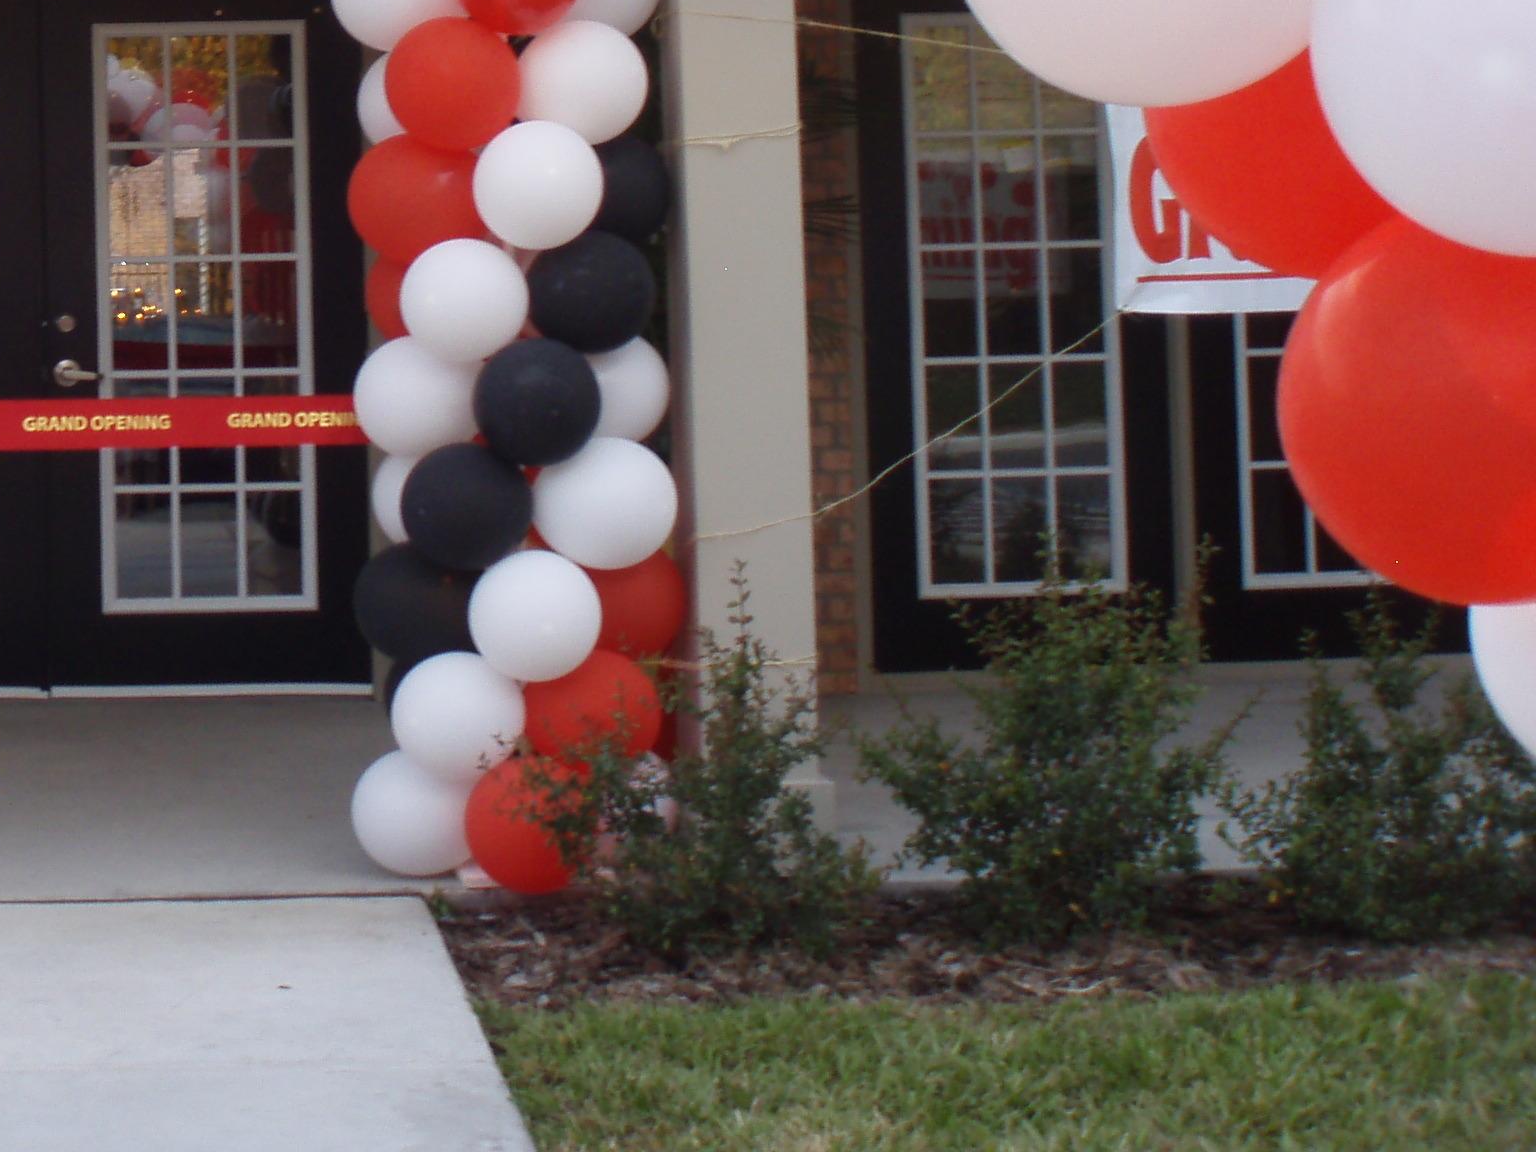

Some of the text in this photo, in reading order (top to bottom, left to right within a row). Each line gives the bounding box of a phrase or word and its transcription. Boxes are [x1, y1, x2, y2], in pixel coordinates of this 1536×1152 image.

[22, 414, 172, 432] GRAND OPENING
[226, 412, 292, 428] GRAND
